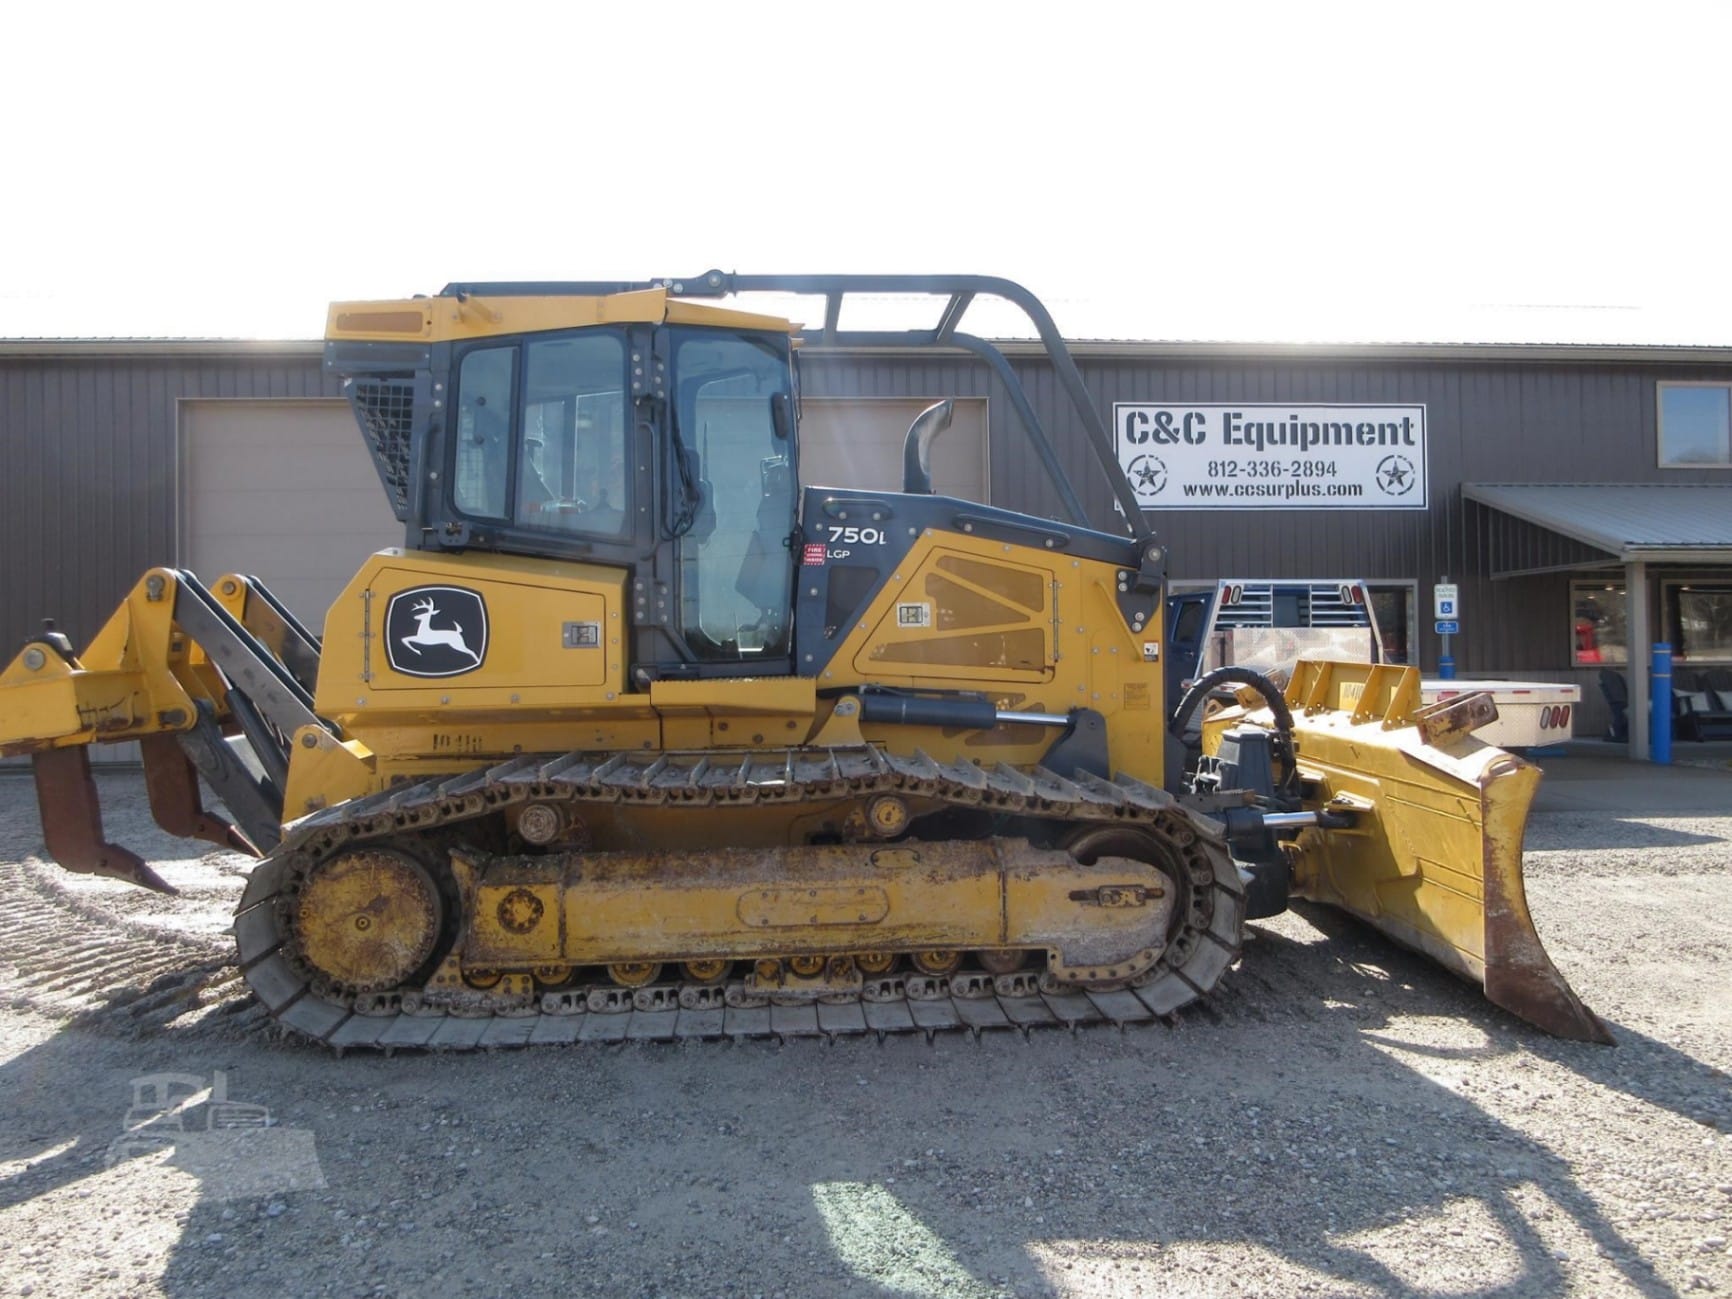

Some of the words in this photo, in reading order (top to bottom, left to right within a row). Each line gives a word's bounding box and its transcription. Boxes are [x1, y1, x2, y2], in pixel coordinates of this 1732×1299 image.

[1126, 411, 1206, 445] C&C
[1223, 412, 1415, 451] Equipment
[1208, 460, 1337, 478] 812-336-2894
[1183, 480, 1363, 499] www.ccsurplus.com
[826, 550, 850, 559] LGP
